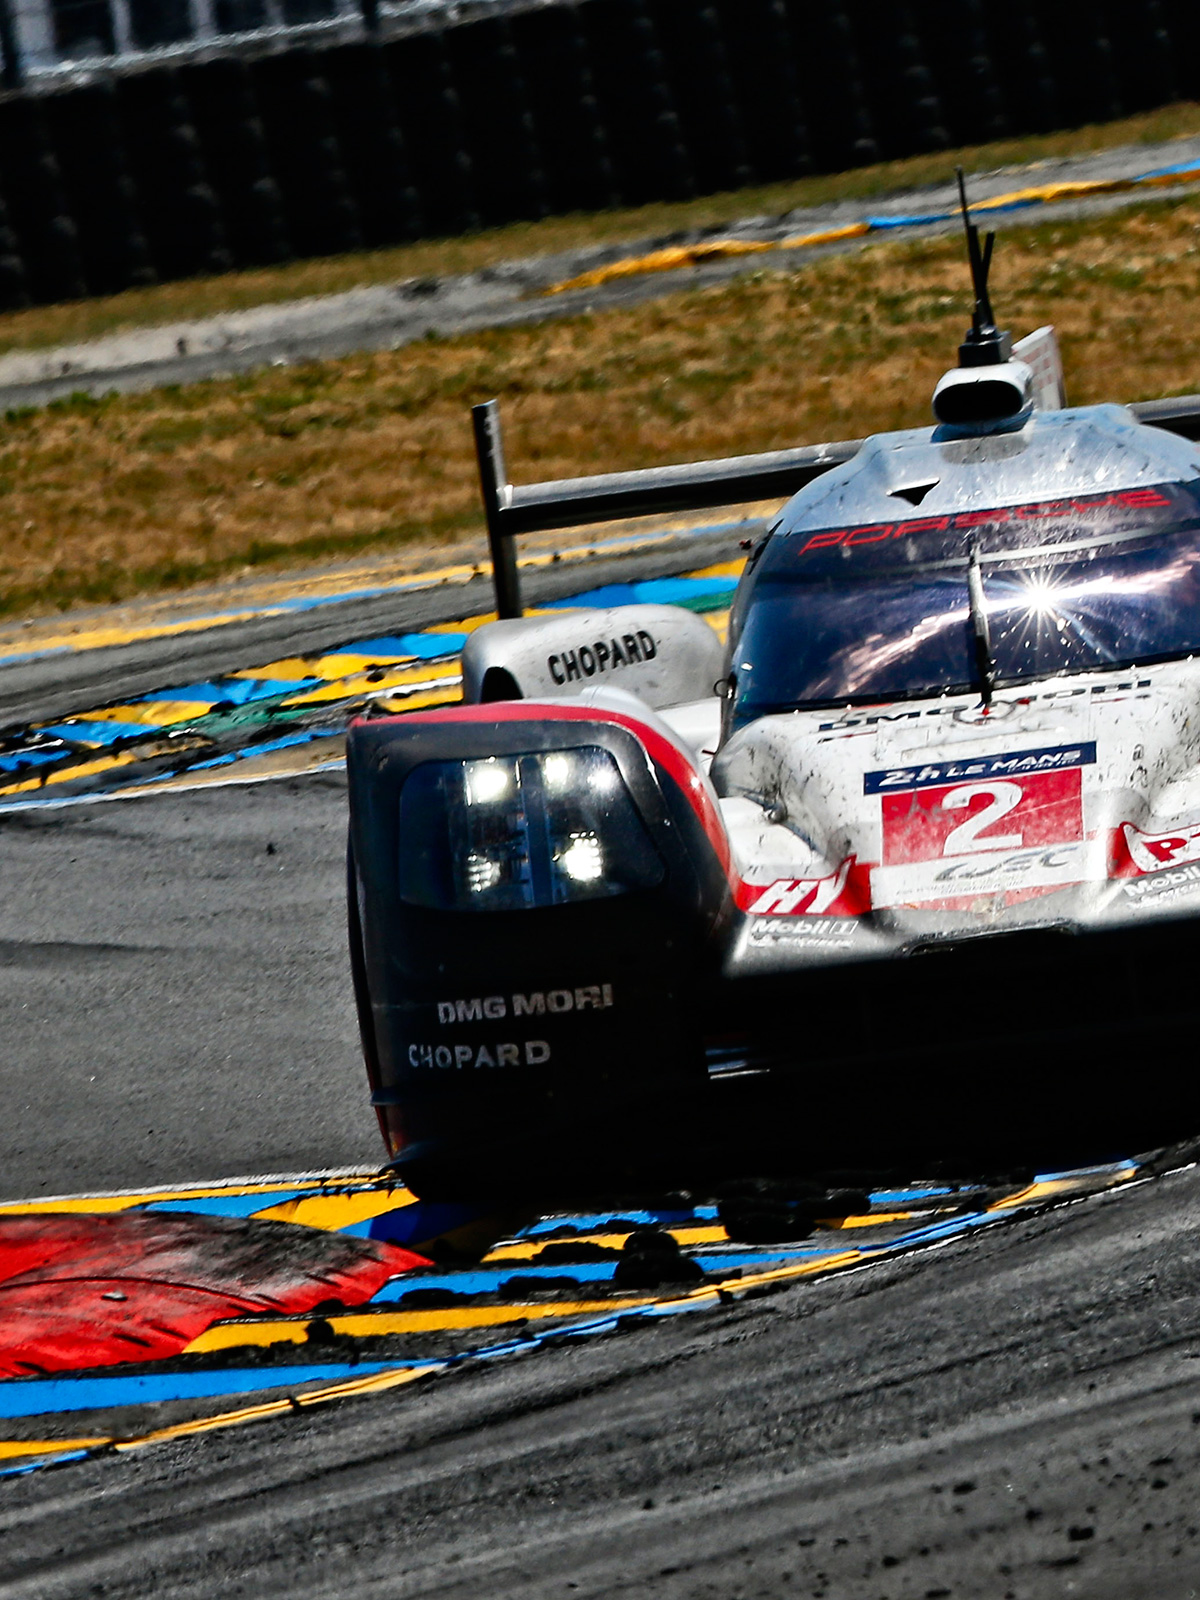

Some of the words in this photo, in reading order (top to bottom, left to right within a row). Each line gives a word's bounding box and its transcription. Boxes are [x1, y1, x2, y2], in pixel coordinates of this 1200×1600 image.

[800, 488, 1171, 556] PORSCHE
[547, 629, 658, 686] CHOPARD
[945, 764, 987, 778] LE
[990, 750, 1081, 772] MANS
[942, 782, 1023, 856] 2
[748, 861, 851, 914] HY
[750, 919, 831, 934] Mobil
[437, 996, 506, 1024] DMG
[511, 983, 614, 1016] MORI
[408, 1040, 551, 1070] CHOPARD
